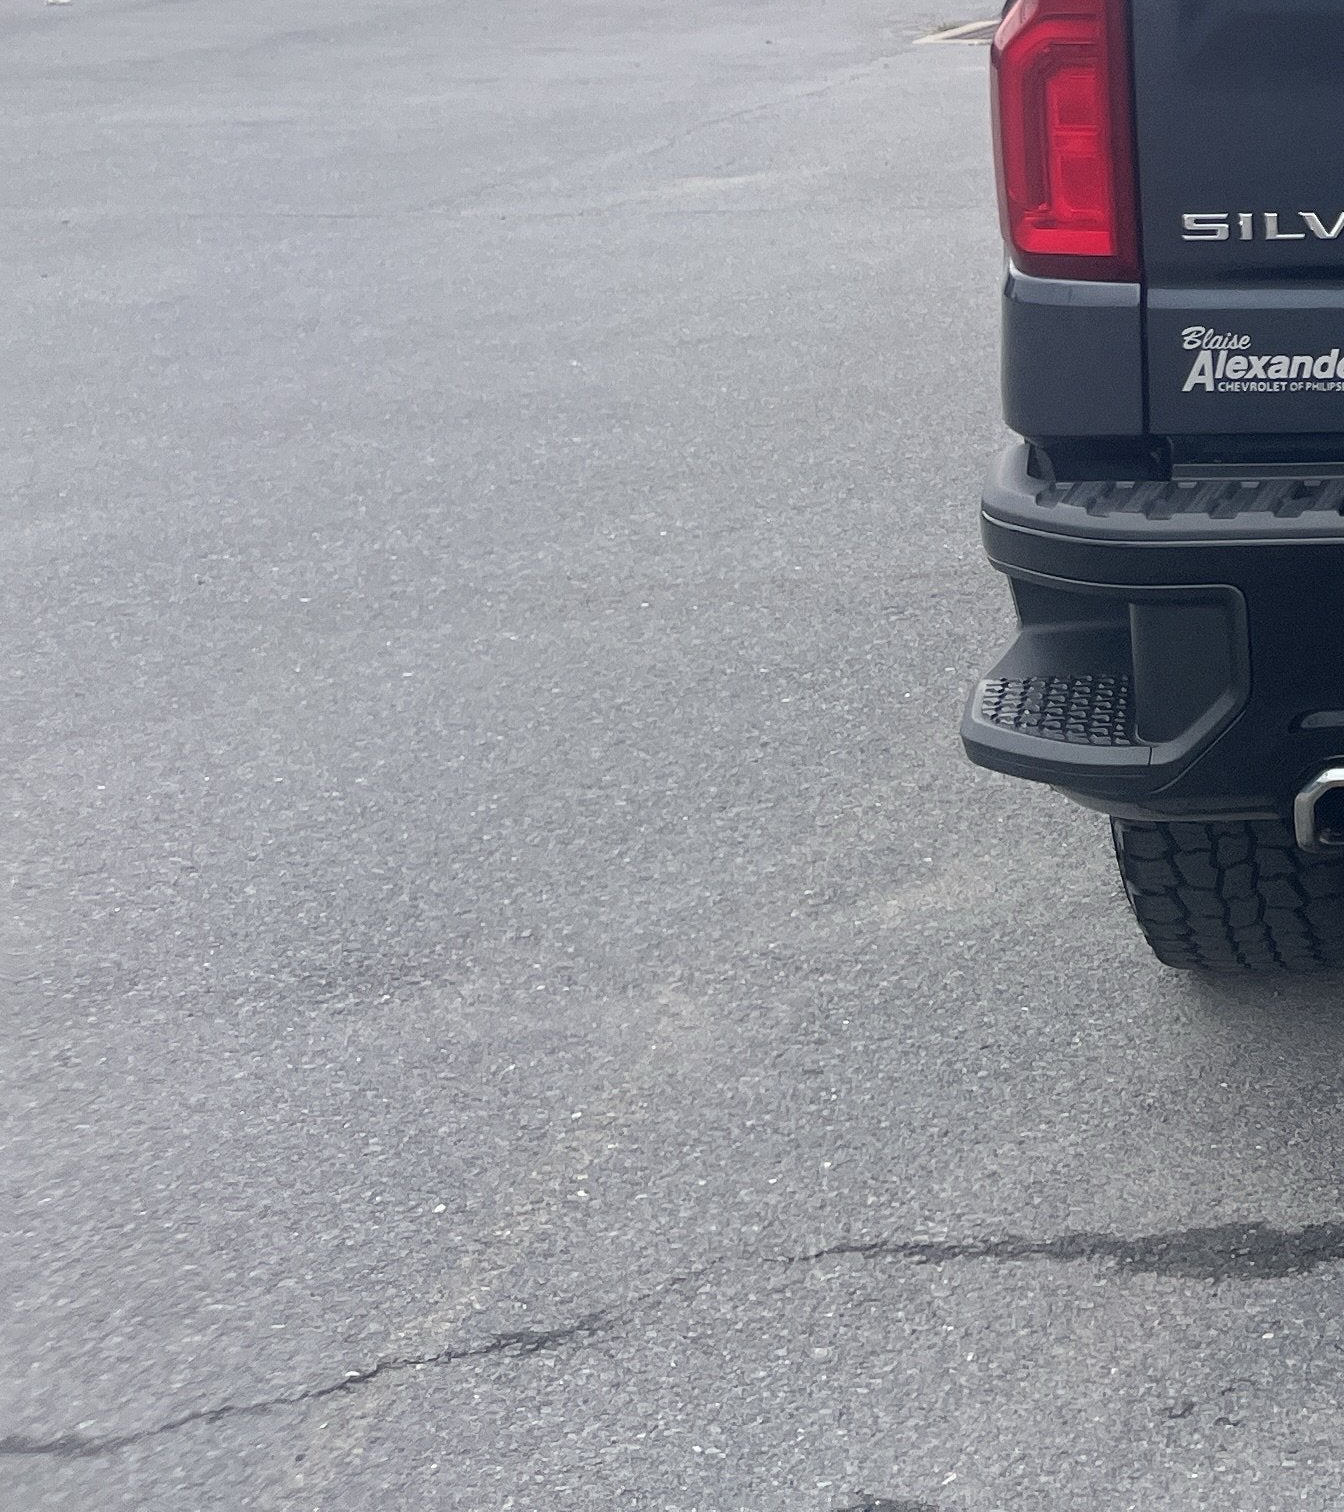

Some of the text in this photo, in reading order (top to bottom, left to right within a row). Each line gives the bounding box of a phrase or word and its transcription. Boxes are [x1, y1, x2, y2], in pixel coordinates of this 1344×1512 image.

[1181, 326, 1251, 350] Blaise
[1218, 381, 1286, 392] CHEVROLET
[1290, 381, 1304, 391] OF
